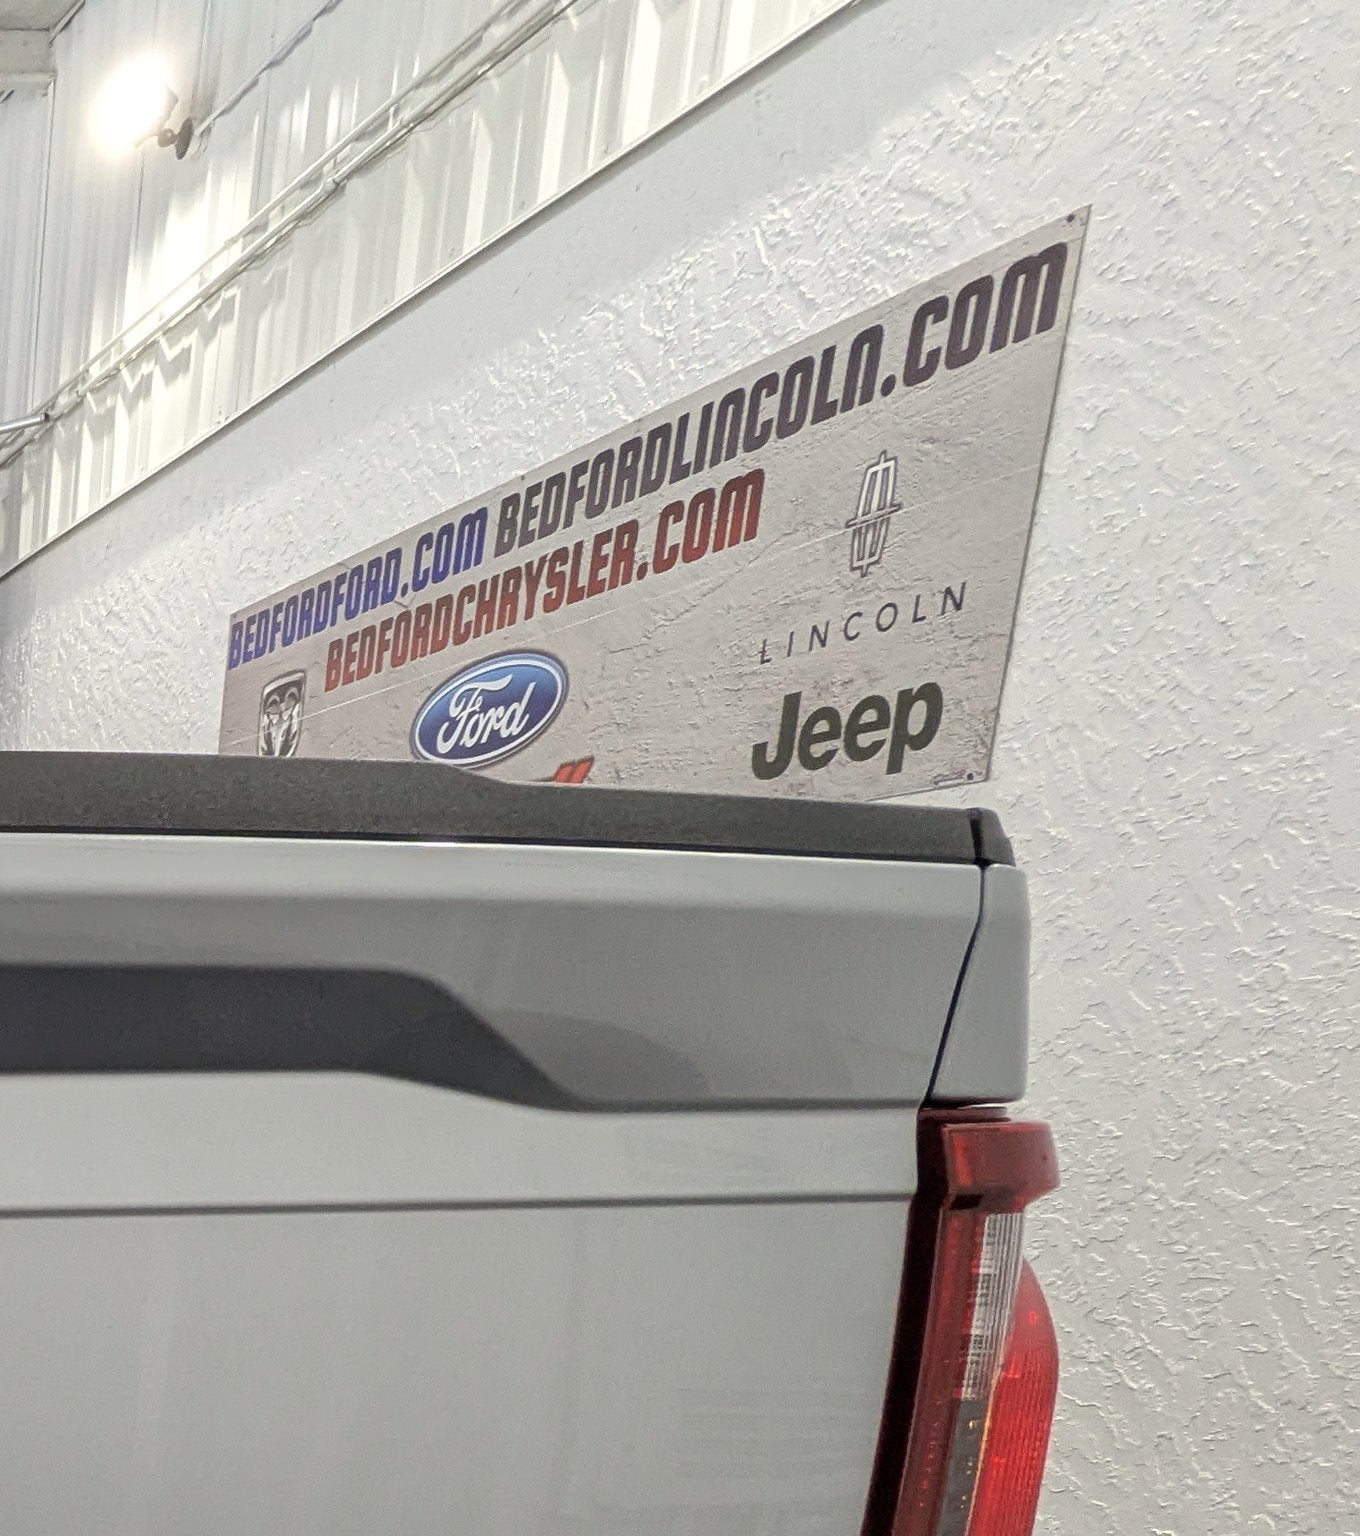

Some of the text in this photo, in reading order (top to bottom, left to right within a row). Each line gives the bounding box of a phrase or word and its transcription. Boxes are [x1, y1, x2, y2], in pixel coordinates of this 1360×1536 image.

[226, 241, 1070, 671] BEDFORDFORD.COM BEDFORDLINCOLN.COM
[324, 468, 766, 693] BEDFORDCHRYSLER.COM
[757, 580, 968, 665] LINCOLN
[436, 673, 536, 755] Ford
[751, 680, 944, 781] Jeep
